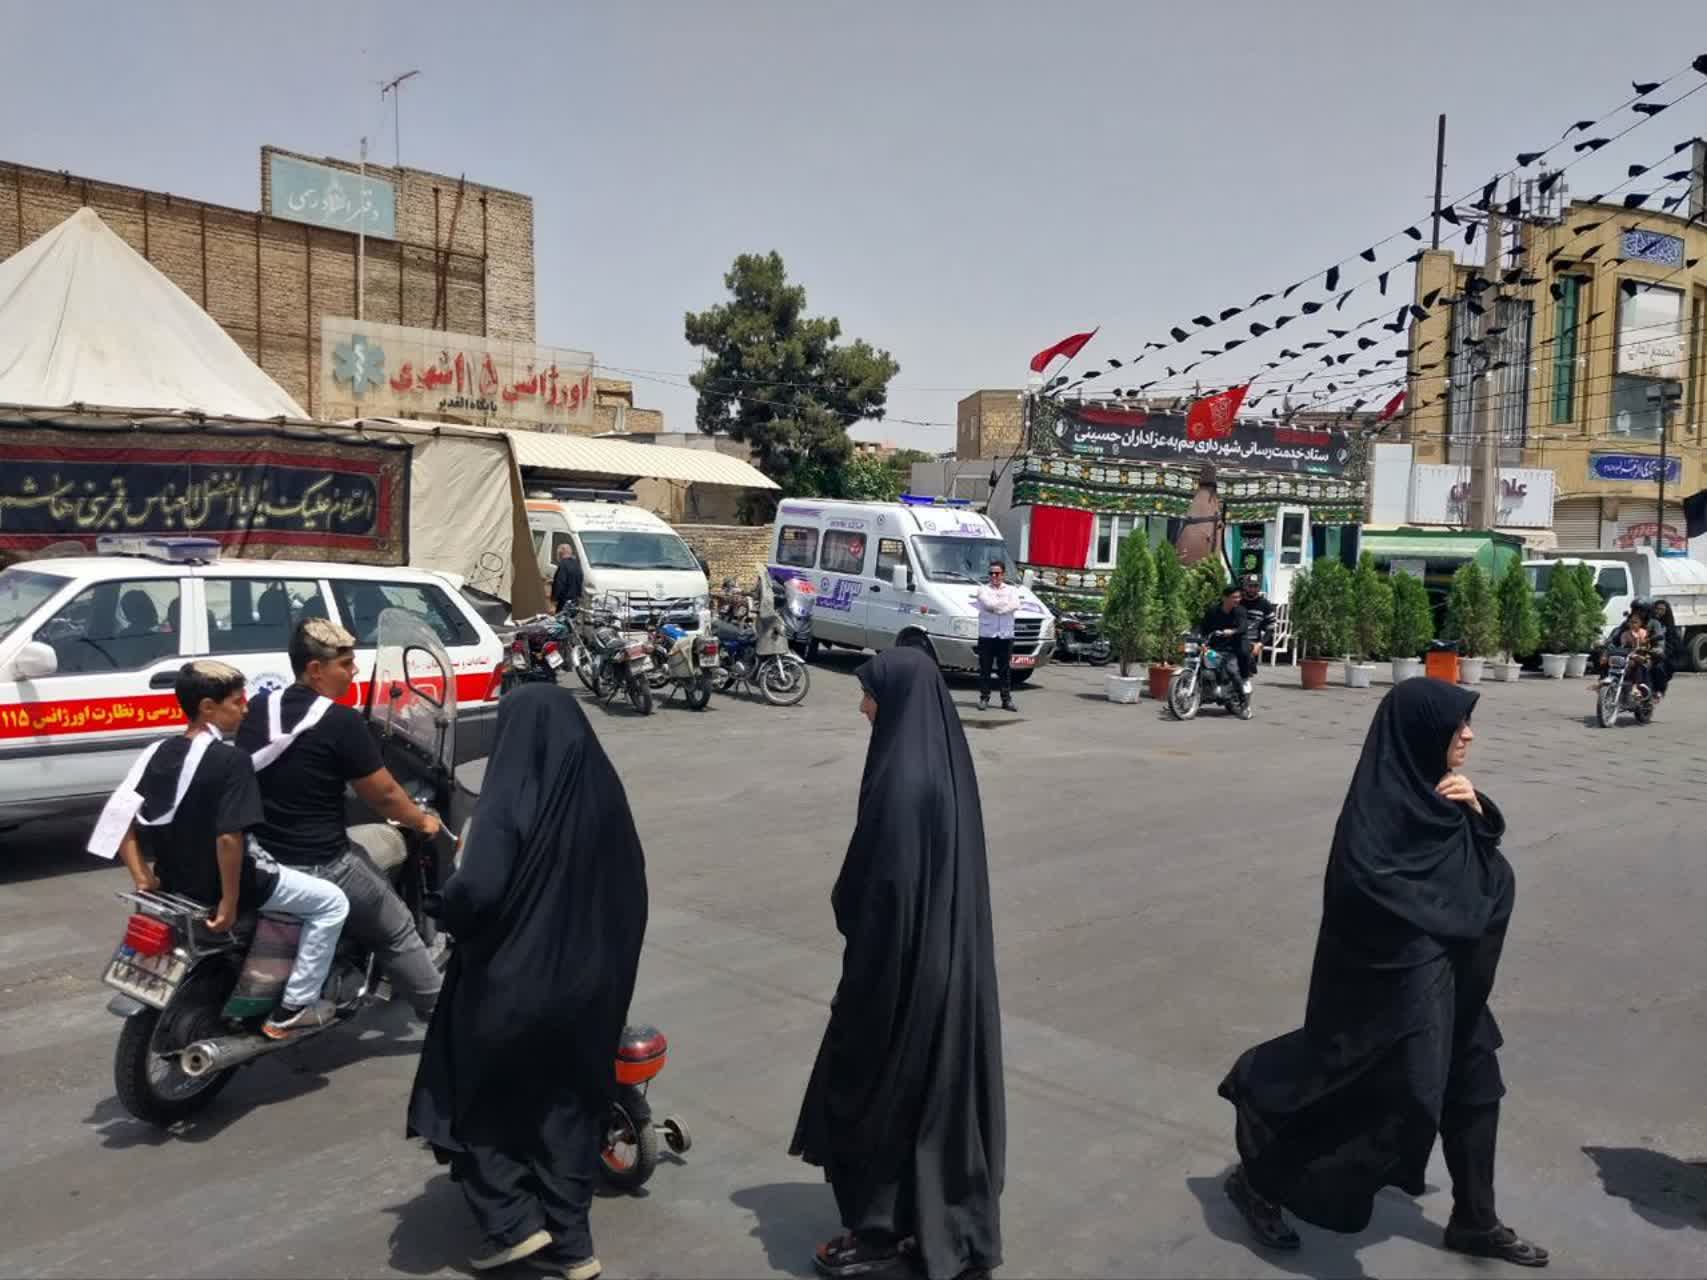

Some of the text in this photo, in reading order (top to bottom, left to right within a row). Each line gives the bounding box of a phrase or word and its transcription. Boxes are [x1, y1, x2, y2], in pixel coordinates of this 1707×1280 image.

[502, 364, 592, 411] اورژانس
[1073, 425, 1121, 443] حسینی
[1120, 428, 1168, 448] عزاداران
[1194, 438, 1241, 457] شهرداری
[1304, 447, 1329, 462] ستاد
[326, 487, 373, 528] السلام
[2, 709, 30, 728] ۱۱۵
[32, 706, 90, 729] اورژانس
[92, 703, 135, 724] نظارت
[136, 706, 145, 722] و
